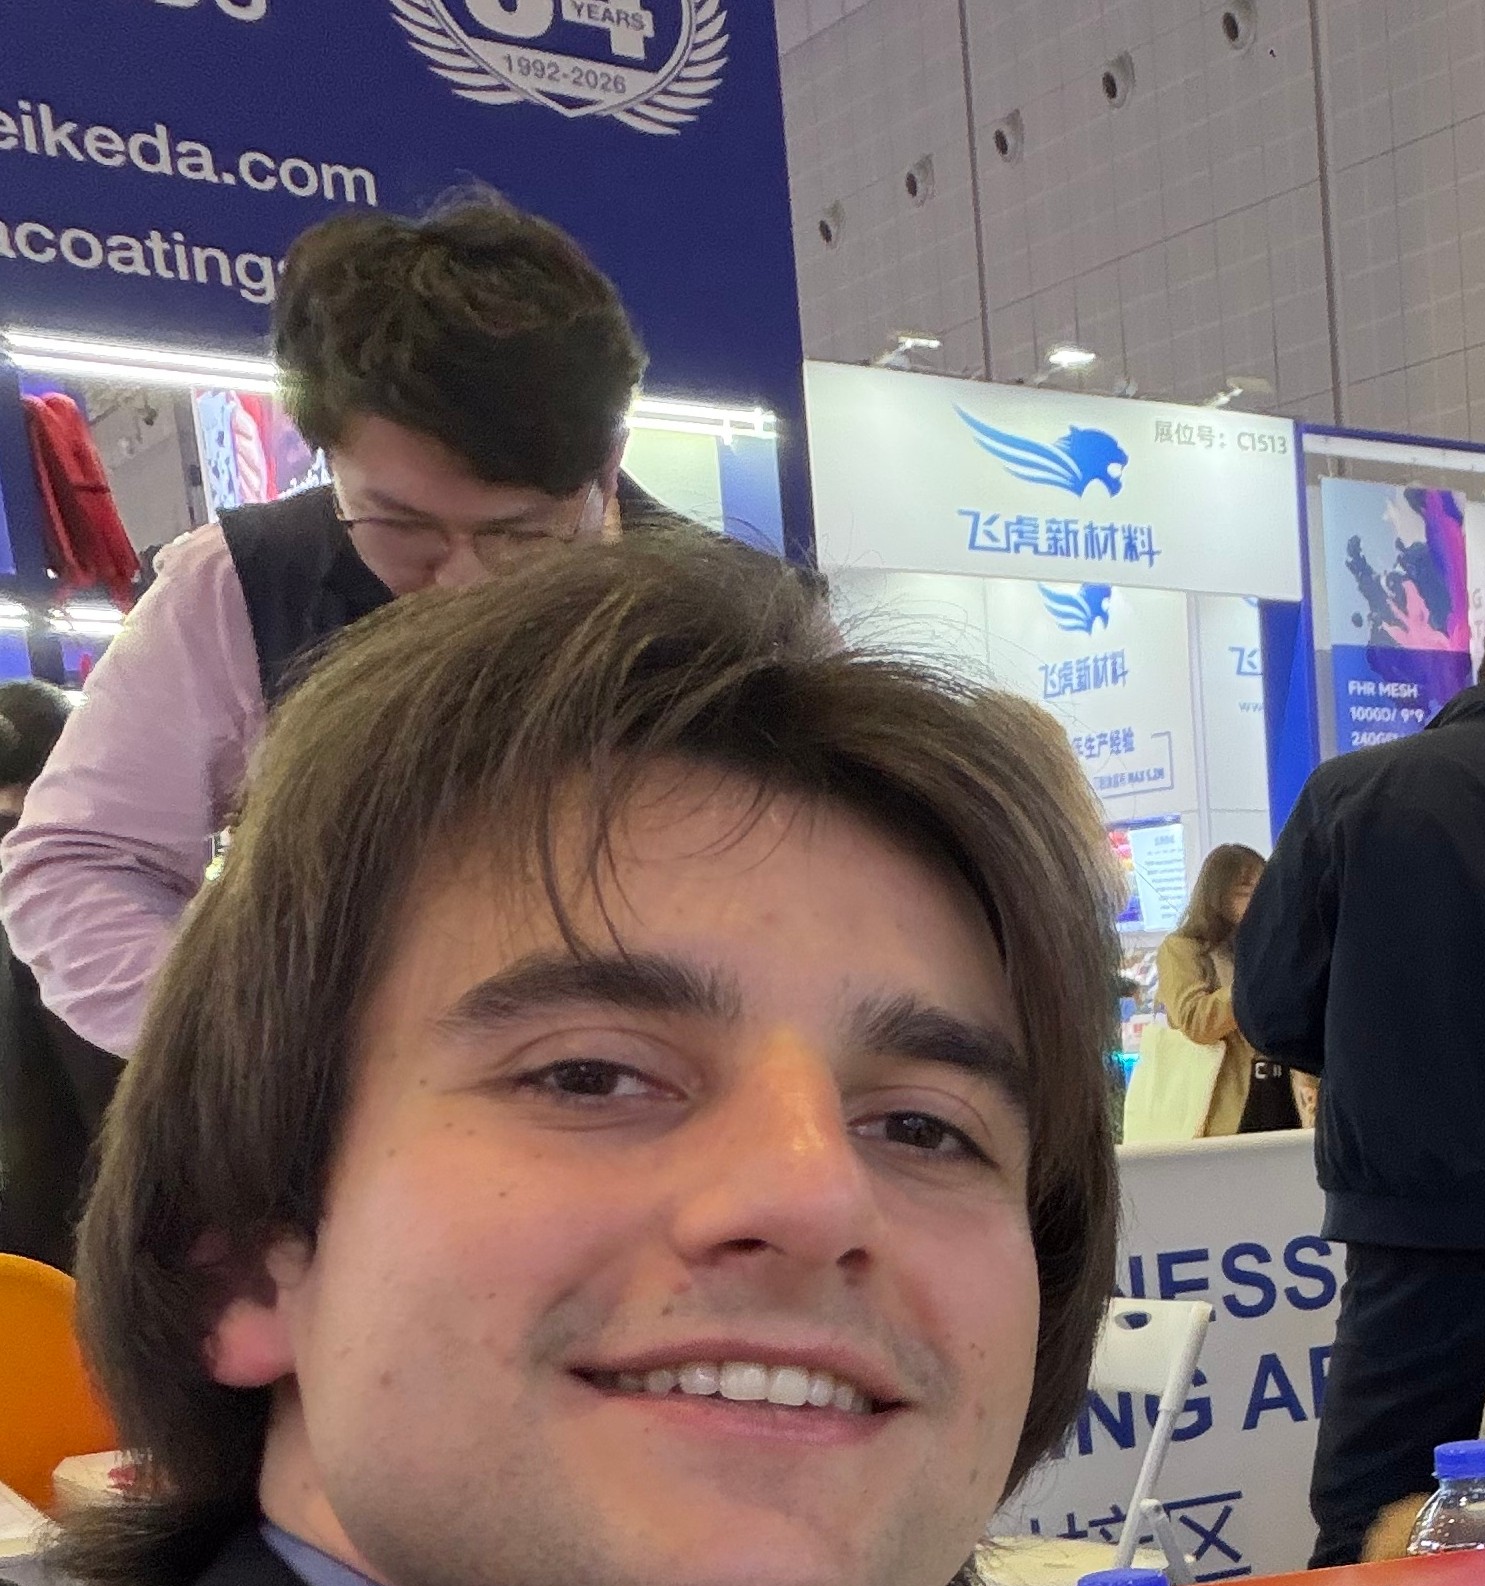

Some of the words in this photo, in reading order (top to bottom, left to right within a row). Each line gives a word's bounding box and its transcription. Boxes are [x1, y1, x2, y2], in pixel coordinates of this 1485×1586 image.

[572, 0, 645, 31] YEARS
[503, 54, 628, 94] 1992-2026
[0, 221, 287, 304] coating
[957, 508, 1162, 569] 飞虎新材料
[1039, 649, 1129, 700] 飞虎新材料
[1348, 680, 1376, 696] FHR
[1379, 682, 1418, 698] MESH
